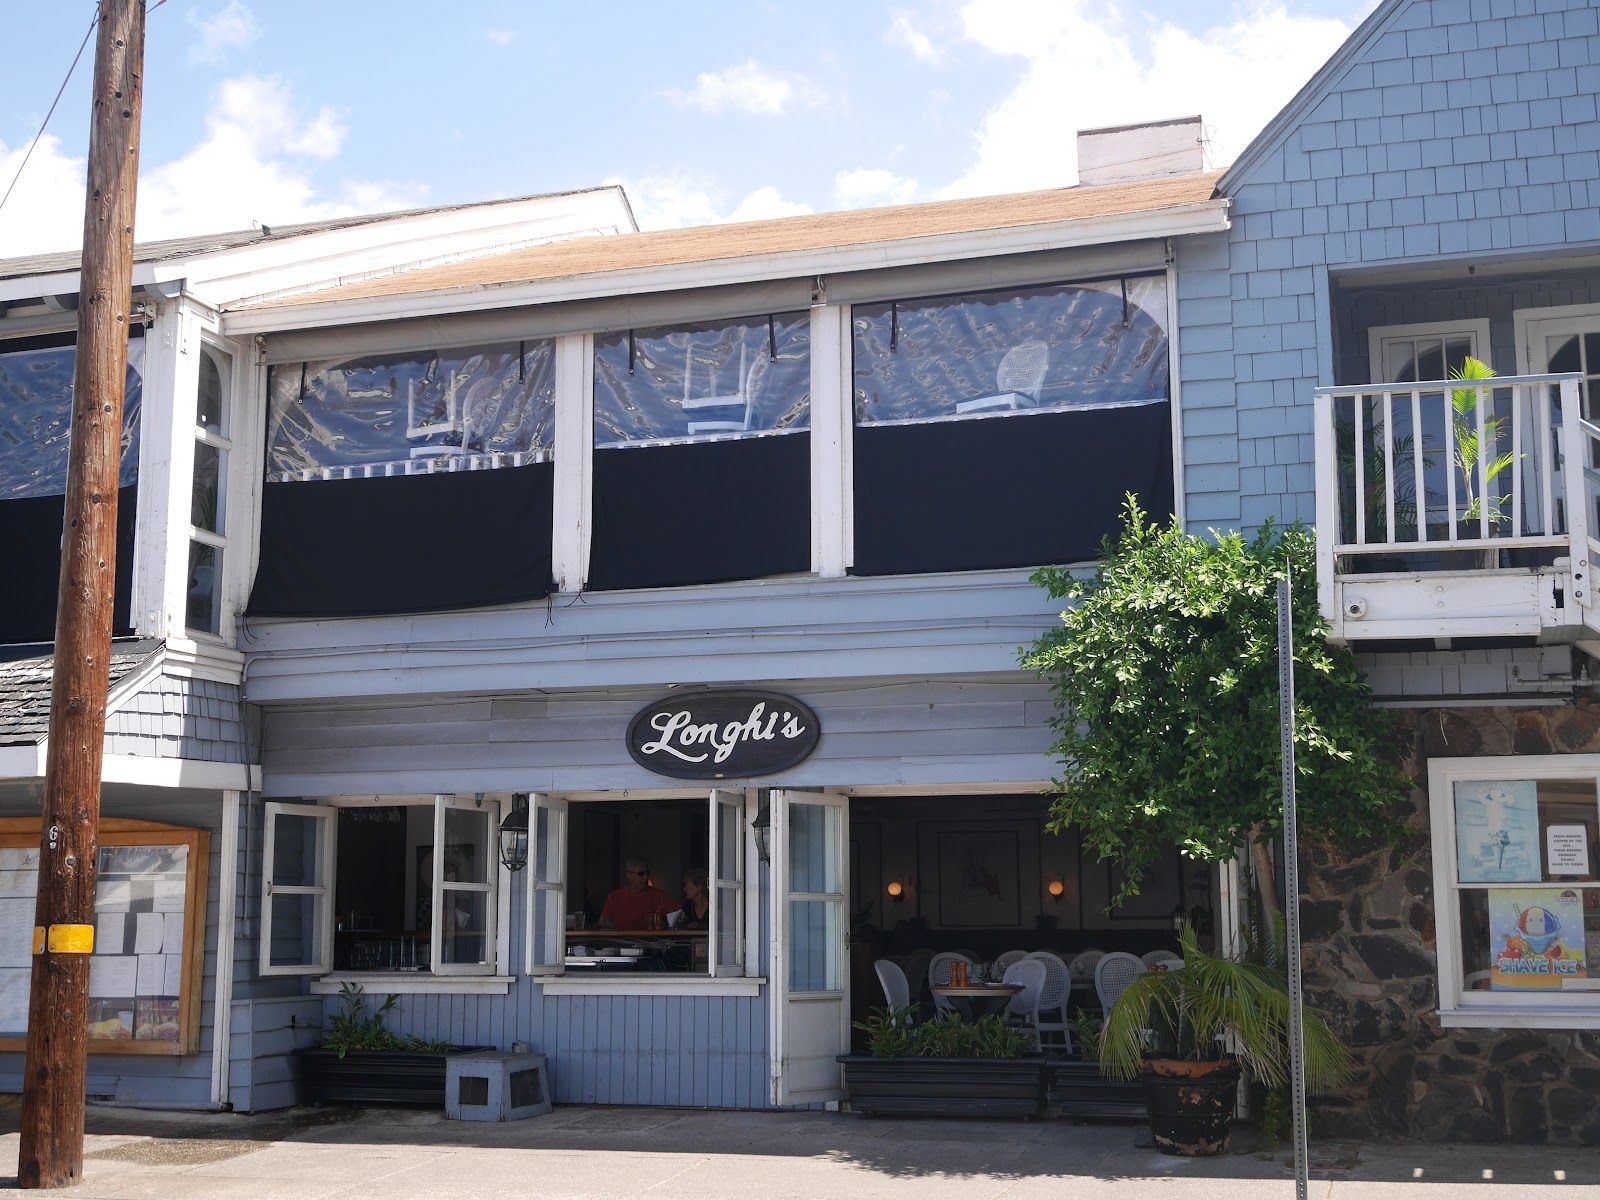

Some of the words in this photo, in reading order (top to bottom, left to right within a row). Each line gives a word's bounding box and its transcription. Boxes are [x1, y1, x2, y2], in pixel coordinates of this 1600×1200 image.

[641, 702, 806, 764] Longhi's
[1500, 959, 1549, 975] SHAVE
[1552, 959, 1578, 975] ICE
